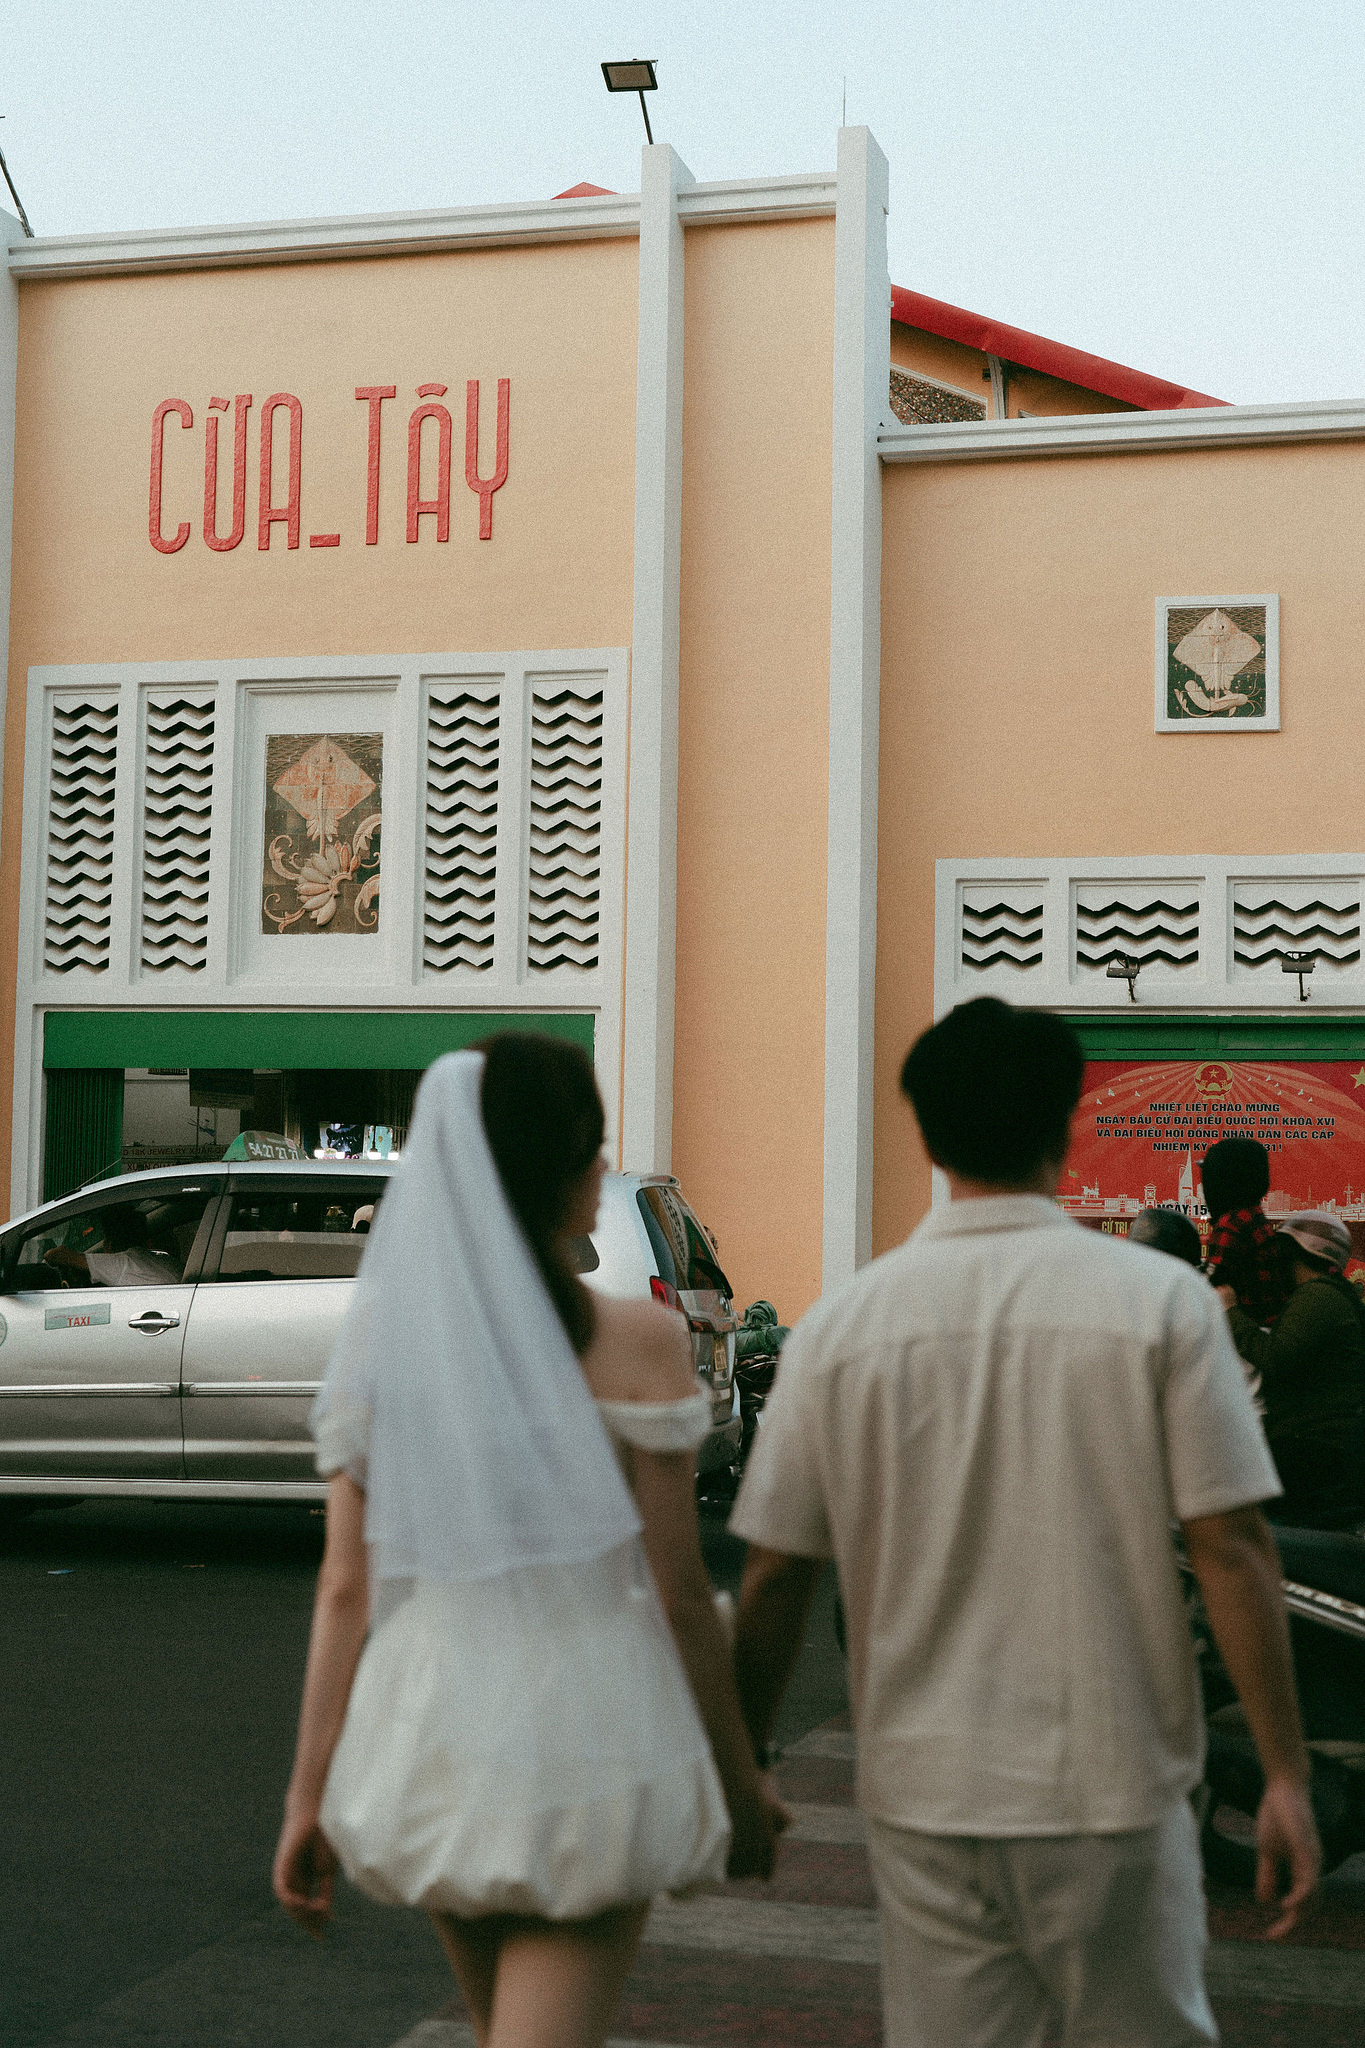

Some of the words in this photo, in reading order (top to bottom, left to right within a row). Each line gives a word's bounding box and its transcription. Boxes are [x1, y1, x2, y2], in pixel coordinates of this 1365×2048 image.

[355, 378, 510, 545] TÂY
[1149, 1102, 1182, 1113] NHIỆT
[1185, 1102, 1208, 1113] LIỆT
[1211, 1101, 1242, 1112] CHÀO
[1245, 1101, 1280, 1112] MỪNG
[1096, 1114, 1126, 1125] NGÀY
[1173, 1116, 1192, 1127] ĐẠI
[1225, 1114, 1256, 1127] QUỐC
[1259, 1115, 1278, 1127] HỘI
[1281, 1115, 1313, 1126] KHÓA
[1316, 1117, 1335, 1126] XVI
[1096, 1127, 1111, 1138] VÀ
[1114, 1129, 1133, 1139] ĐẠI
[1165, 1128, 1184, 1140] HỘI
[1222, 1128, 1254, 1139] NHÂN
[1284, 1129, 1308, 1139] CÁC
[1153, 1141, 1190, 1153] NHIỆM
[67, 1317, 90, 1327] TAXI
